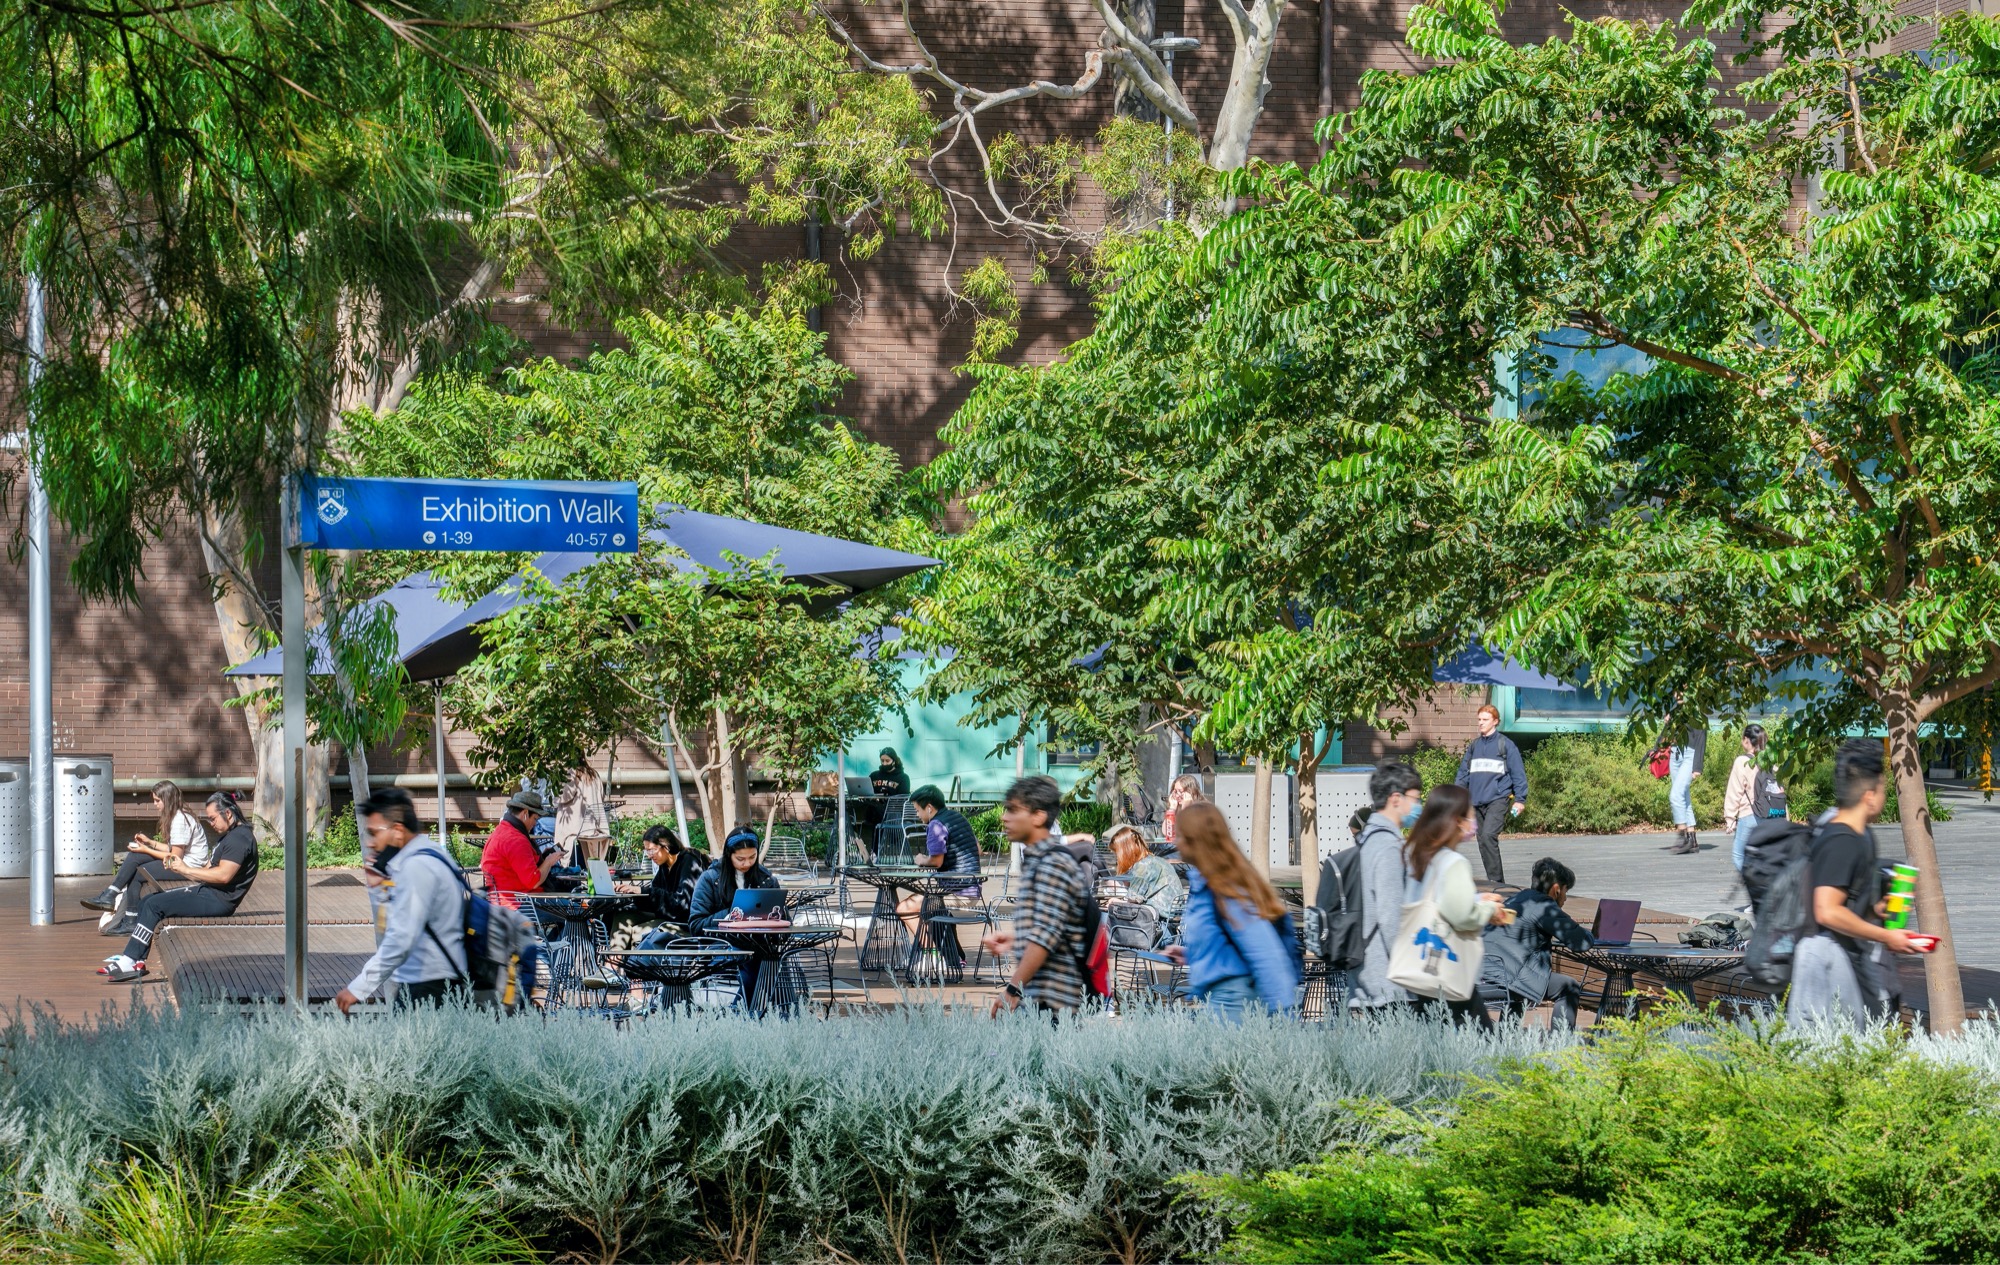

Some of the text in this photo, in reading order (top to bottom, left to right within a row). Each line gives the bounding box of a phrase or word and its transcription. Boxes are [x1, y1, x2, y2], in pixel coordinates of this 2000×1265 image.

[422, 496, 625, 524] Exhibition Walk
[441, 531, 473, 545] 1-39
[565, 533, 608, 546] 40-57
